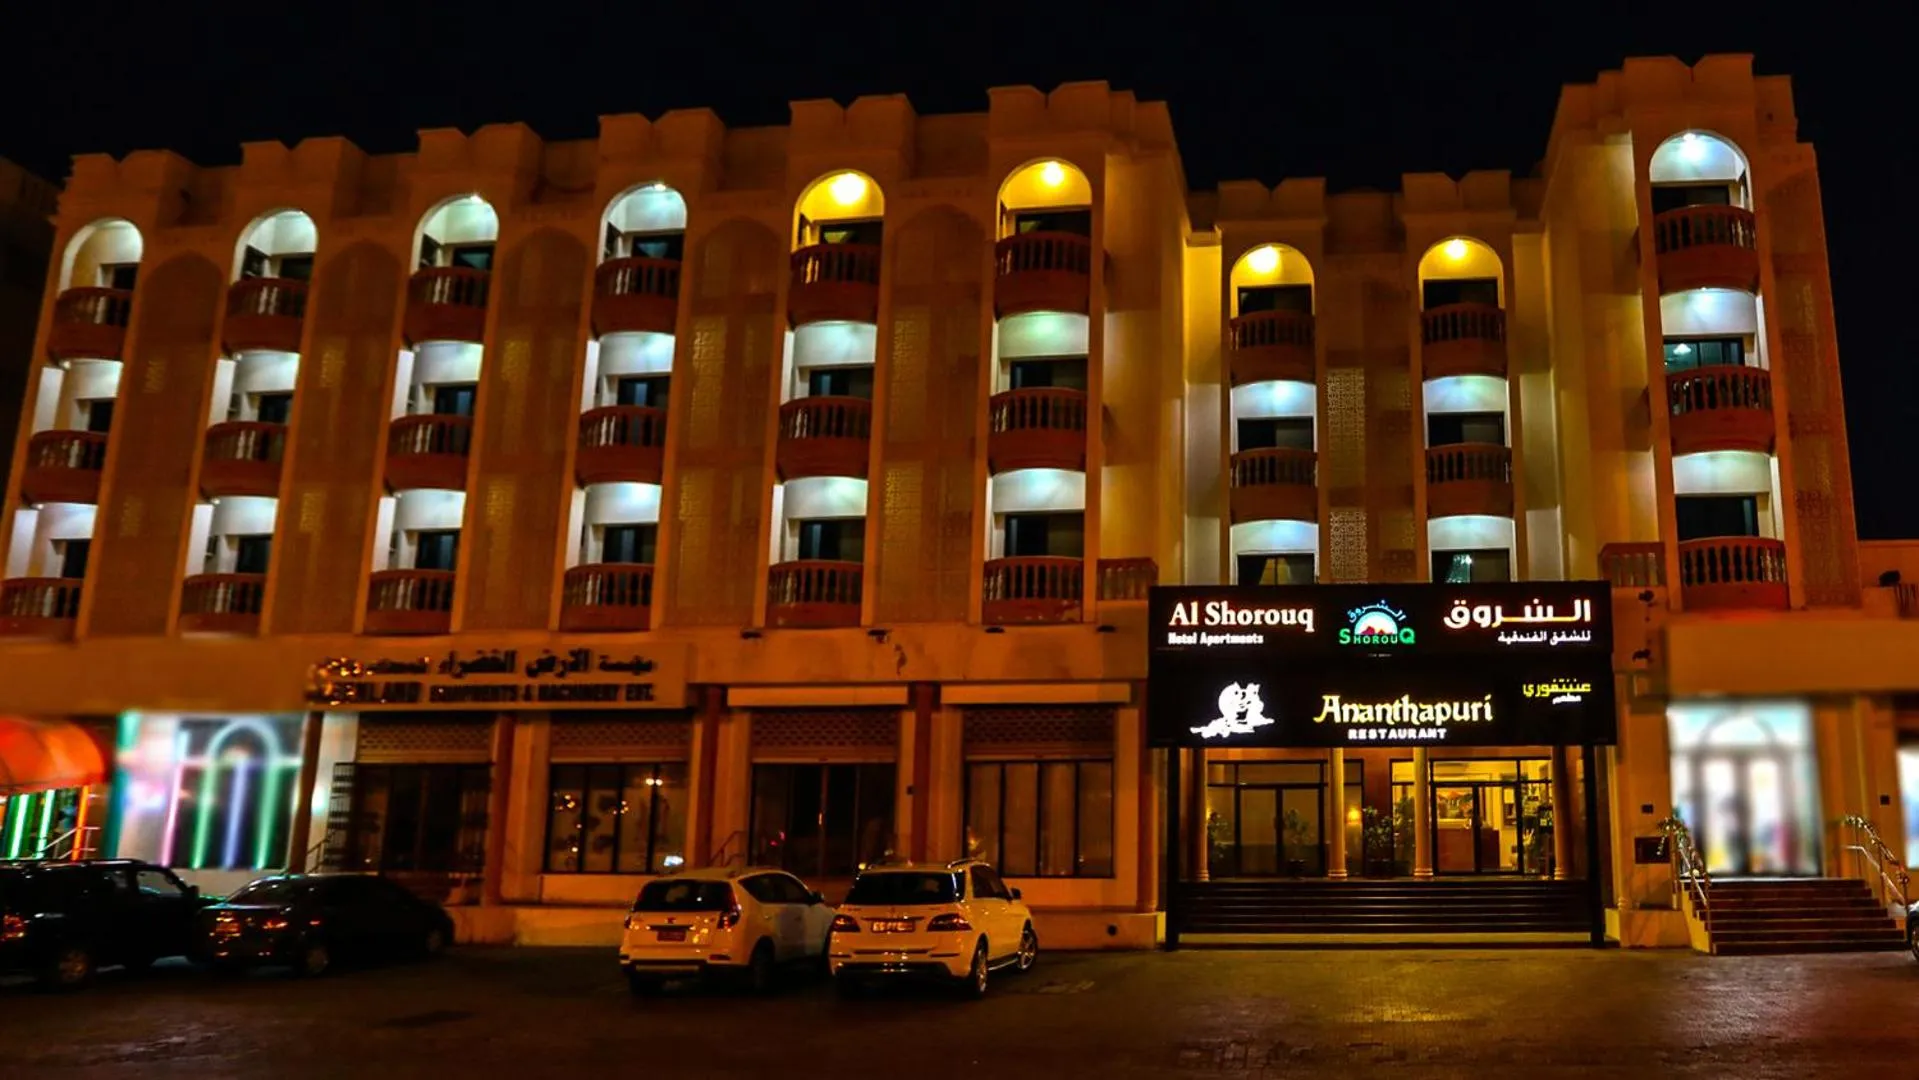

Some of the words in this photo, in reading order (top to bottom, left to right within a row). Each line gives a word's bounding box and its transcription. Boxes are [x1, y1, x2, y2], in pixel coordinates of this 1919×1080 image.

[1168, 600, 1199, 627] Al
[1203, 600, 1315, 634] Shorouq
[1443, 598, 1592, 630] الشروق
[1167, 631, 1198, 645] Hotel
[1199, 631, 1265, 647] Apartments
[1313, 694, 1494, 727] Ananthapuri
[1347, 727, 1447, 740] RESTAURANT
